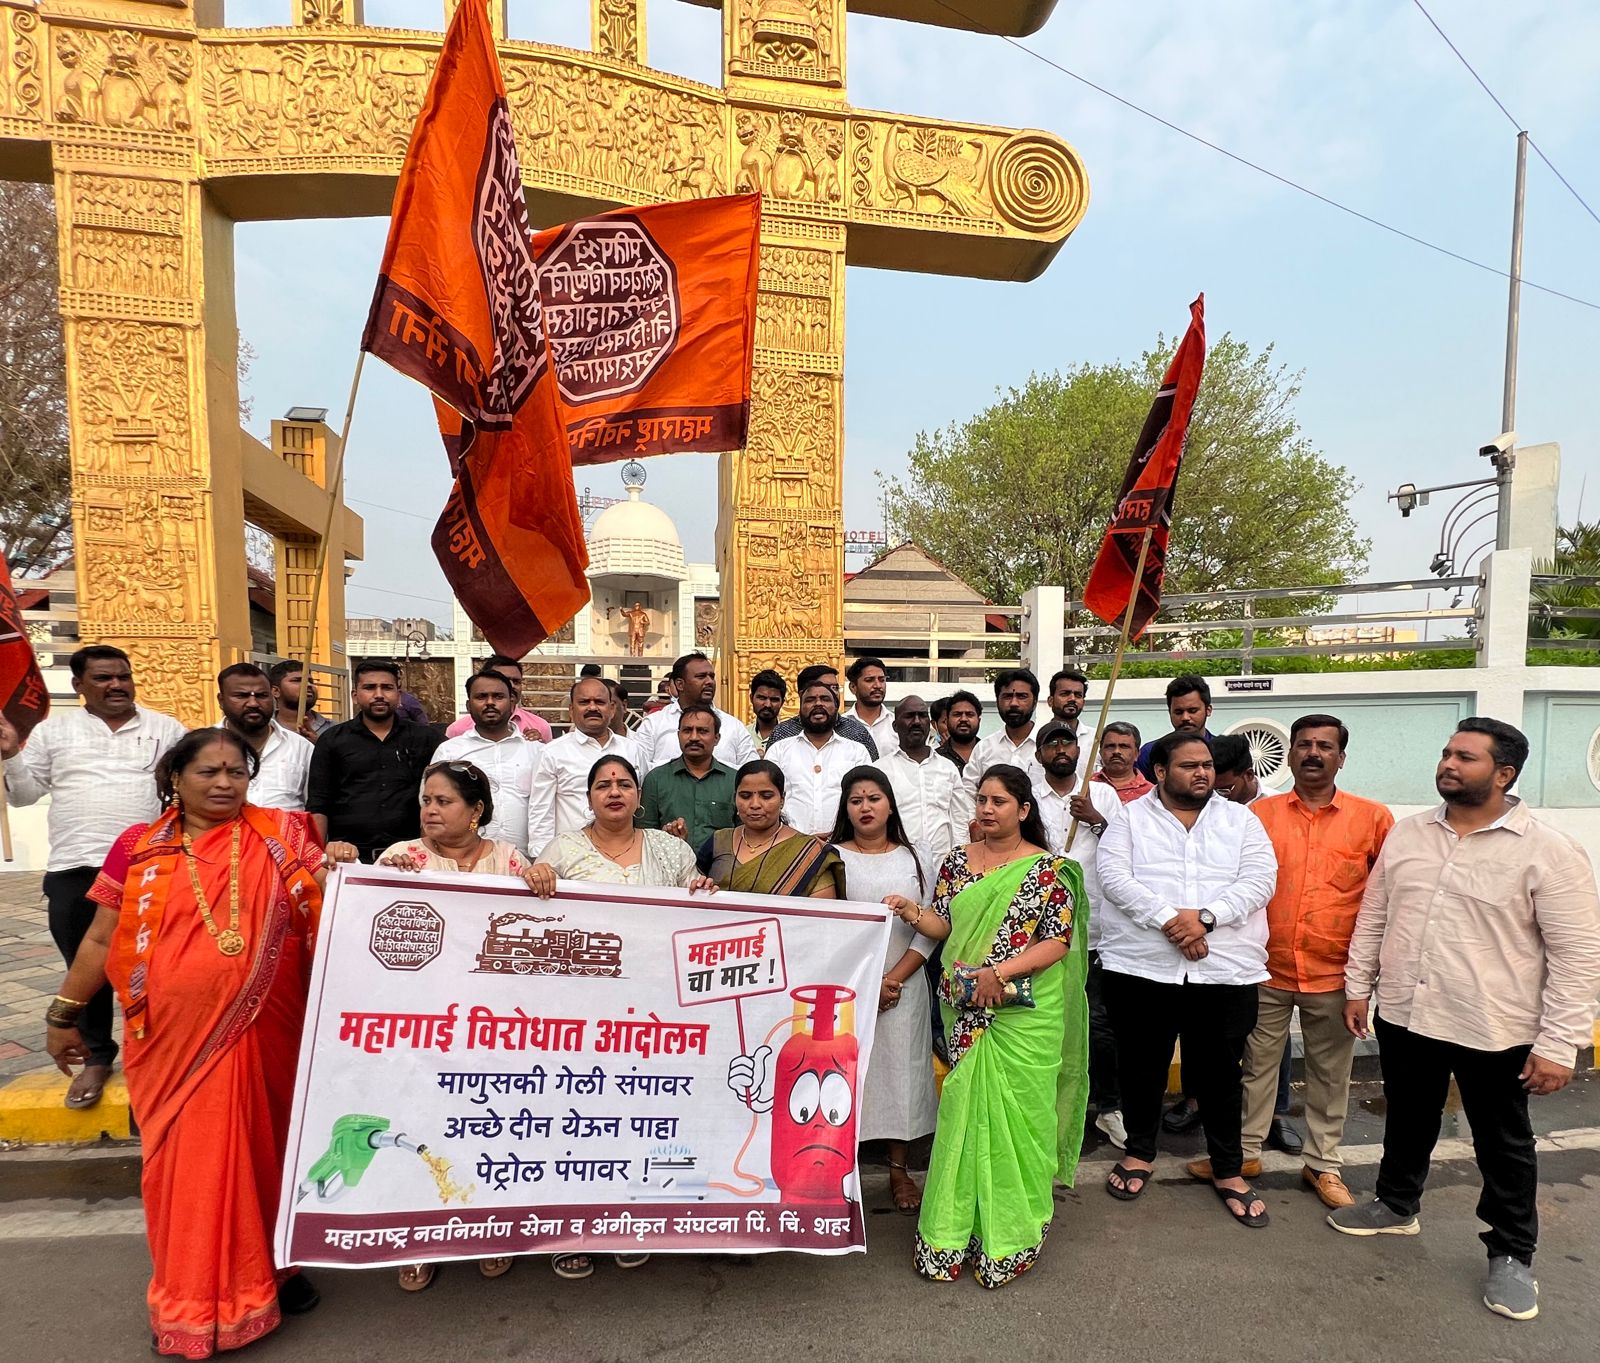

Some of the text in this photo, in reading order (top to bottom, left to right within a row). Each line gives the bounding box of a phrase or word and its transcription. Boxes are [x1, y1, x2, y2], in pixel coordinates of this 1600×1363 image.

[688, 927, 766, 967] महागाई
[688, 969, 714, 992] चा
[721, 963, 760, 987] मार
[339, 1003, 710, 1059] महागाई विरोधात आंदोलन
[437, 1064, 694, 1104] माणुसकी गेली संपावर
[444, 1108, 679, 1140] अच्छे दीन येऊन पाहा
[476, 1152, 546, 1192] पेट्रोल
[555, 1150, 631, 1182] पंपावर
[325, 1226, 410, 1249] महाराष्ट्र
[413, 1215, 514, 1243] नवनिर्माण
[520, 1213, 564, 1237] सेना
[570, 1218, 585, 1235] व
[591, 1211, 667, 1241] अंगीकृत
[673, 1211, 739, 1234] संघटना
[746, 1210, 771, 1233] पिं.
[779, 1211, 805, 1233] चिं.
